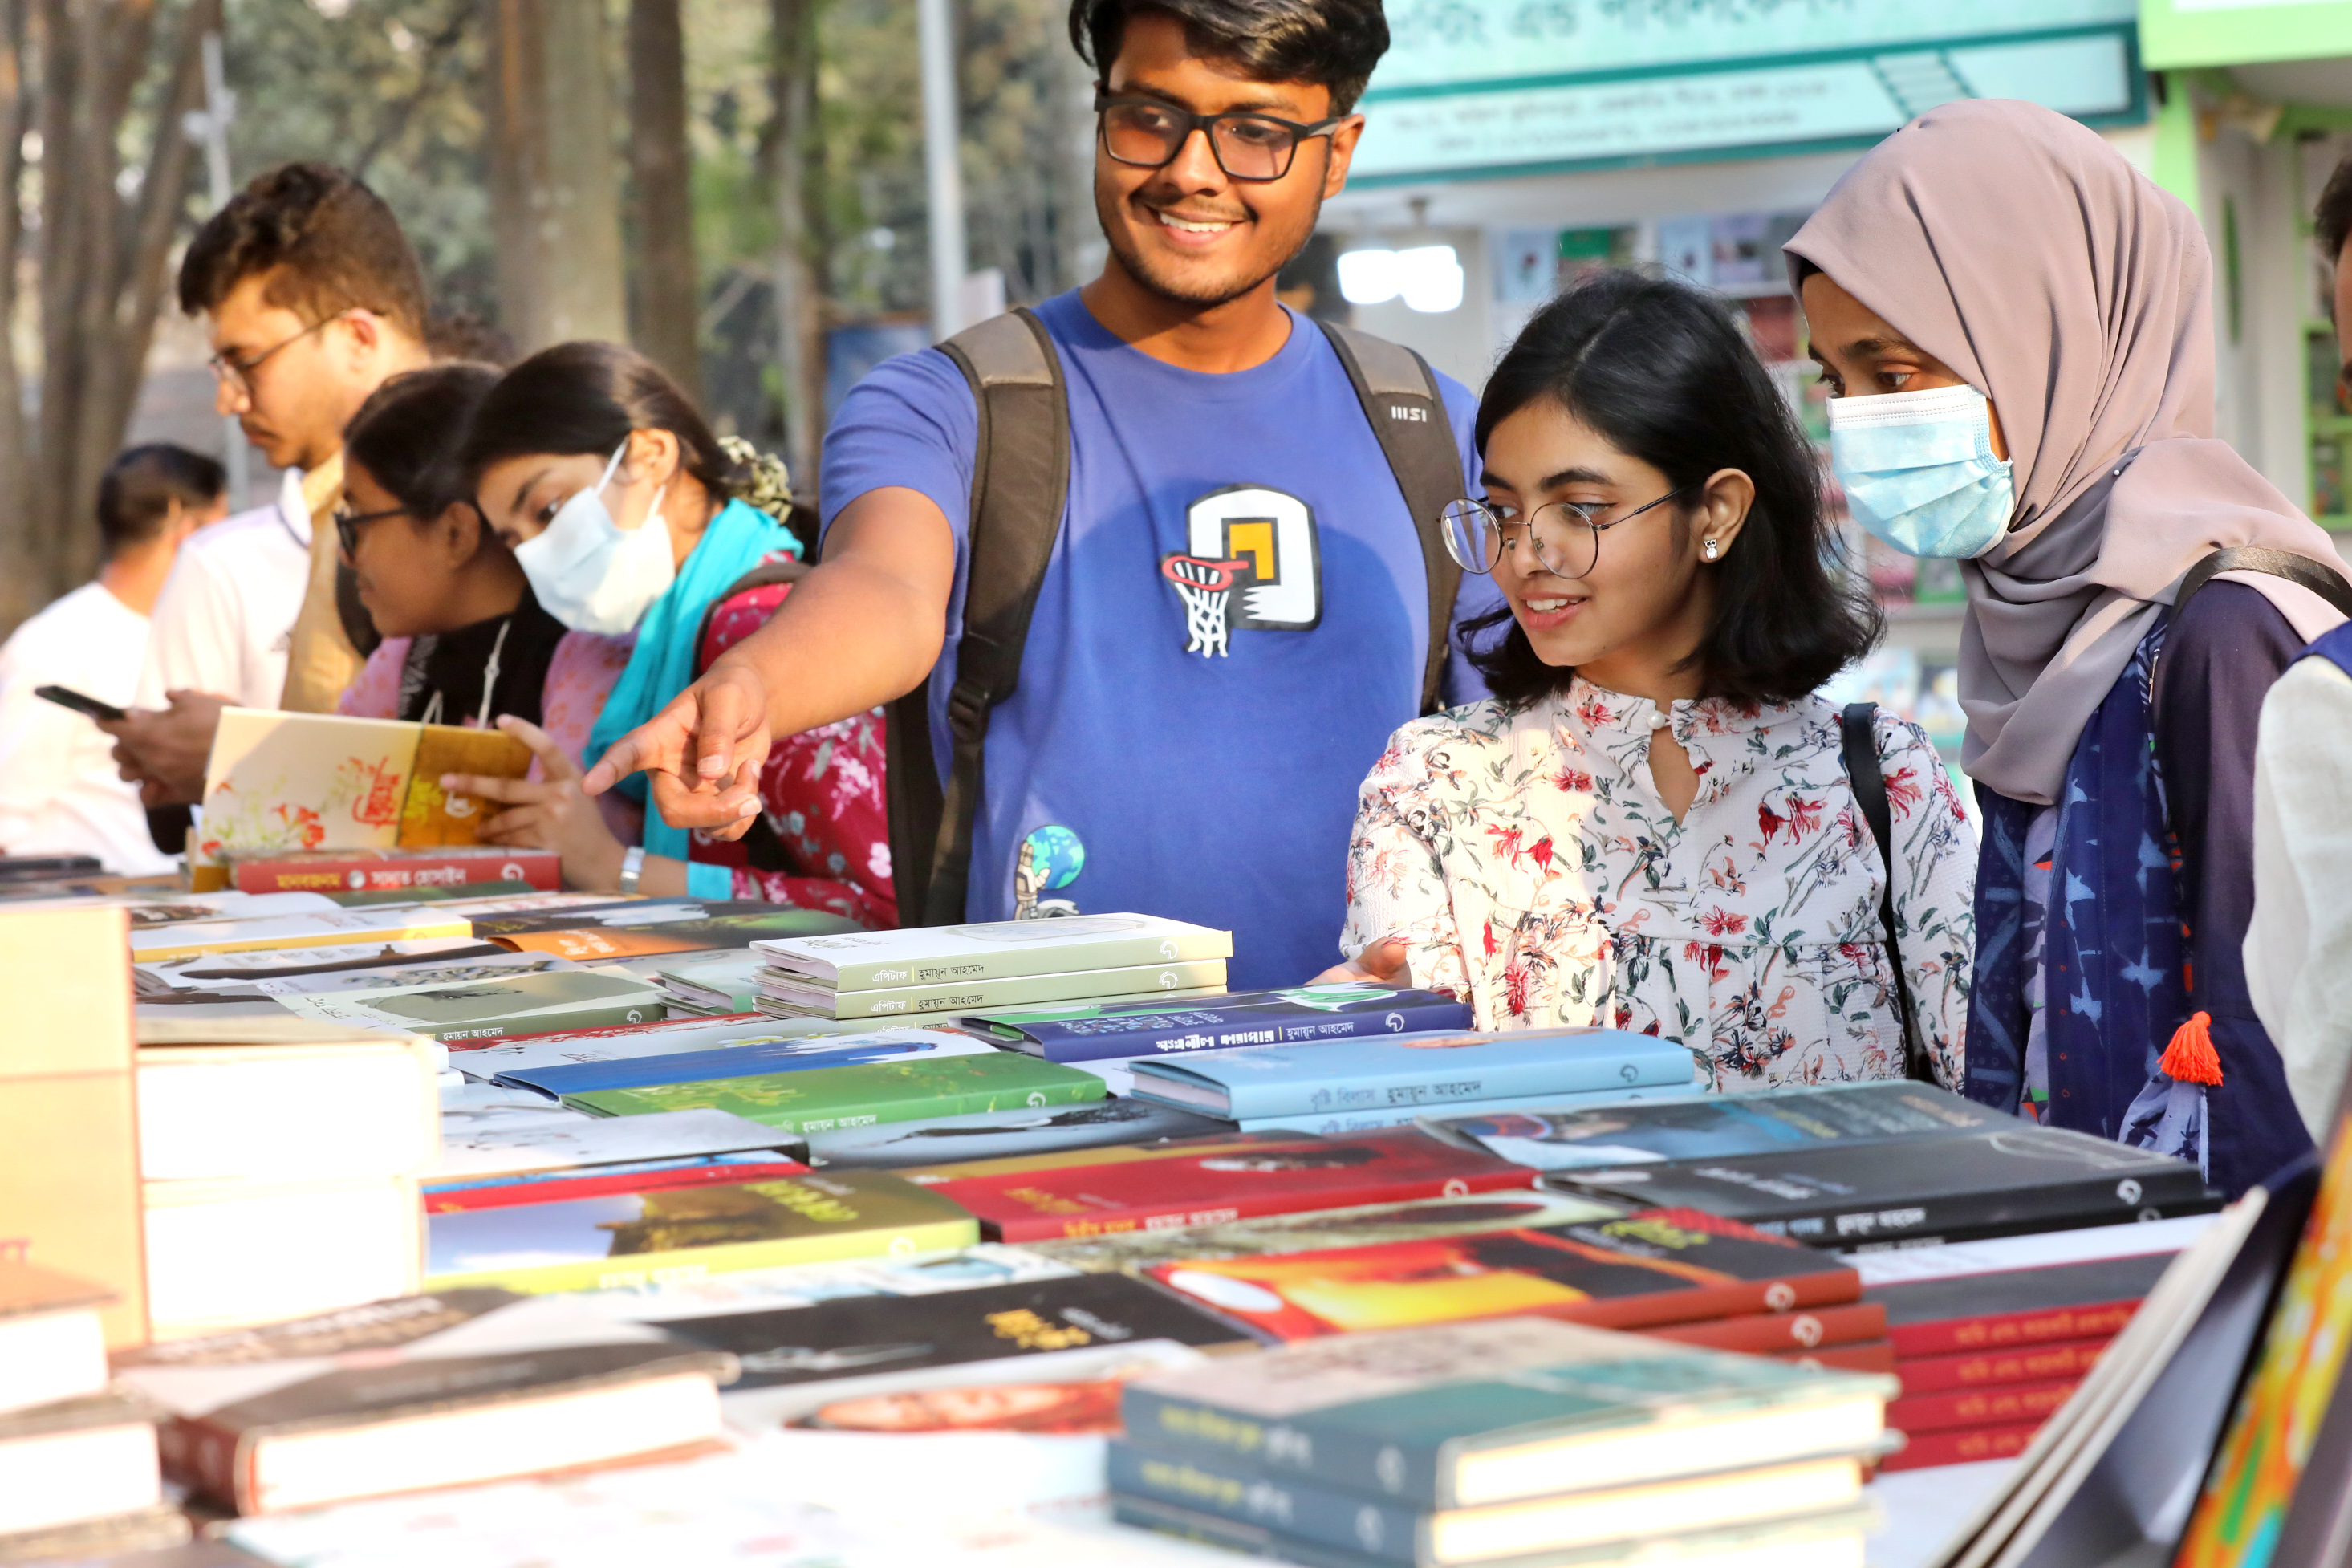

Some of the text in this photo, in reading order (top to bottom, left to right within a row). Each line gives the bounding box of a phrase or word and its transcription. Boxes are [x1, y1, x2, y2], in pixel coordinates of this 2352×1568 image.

[872, 964, 985, 983] এপিটাফ হুমায়ূন আহমেদ
[871, 994, 984, 1013] এপিটাফ হুমায়ূন আহমেদ
[471, 1027, 503, 1038] আহমেদ
[1286, 1025, 1316, 1041] হুমায়ূন
[1318, 1022, 1355, 1035] আহমেদ
